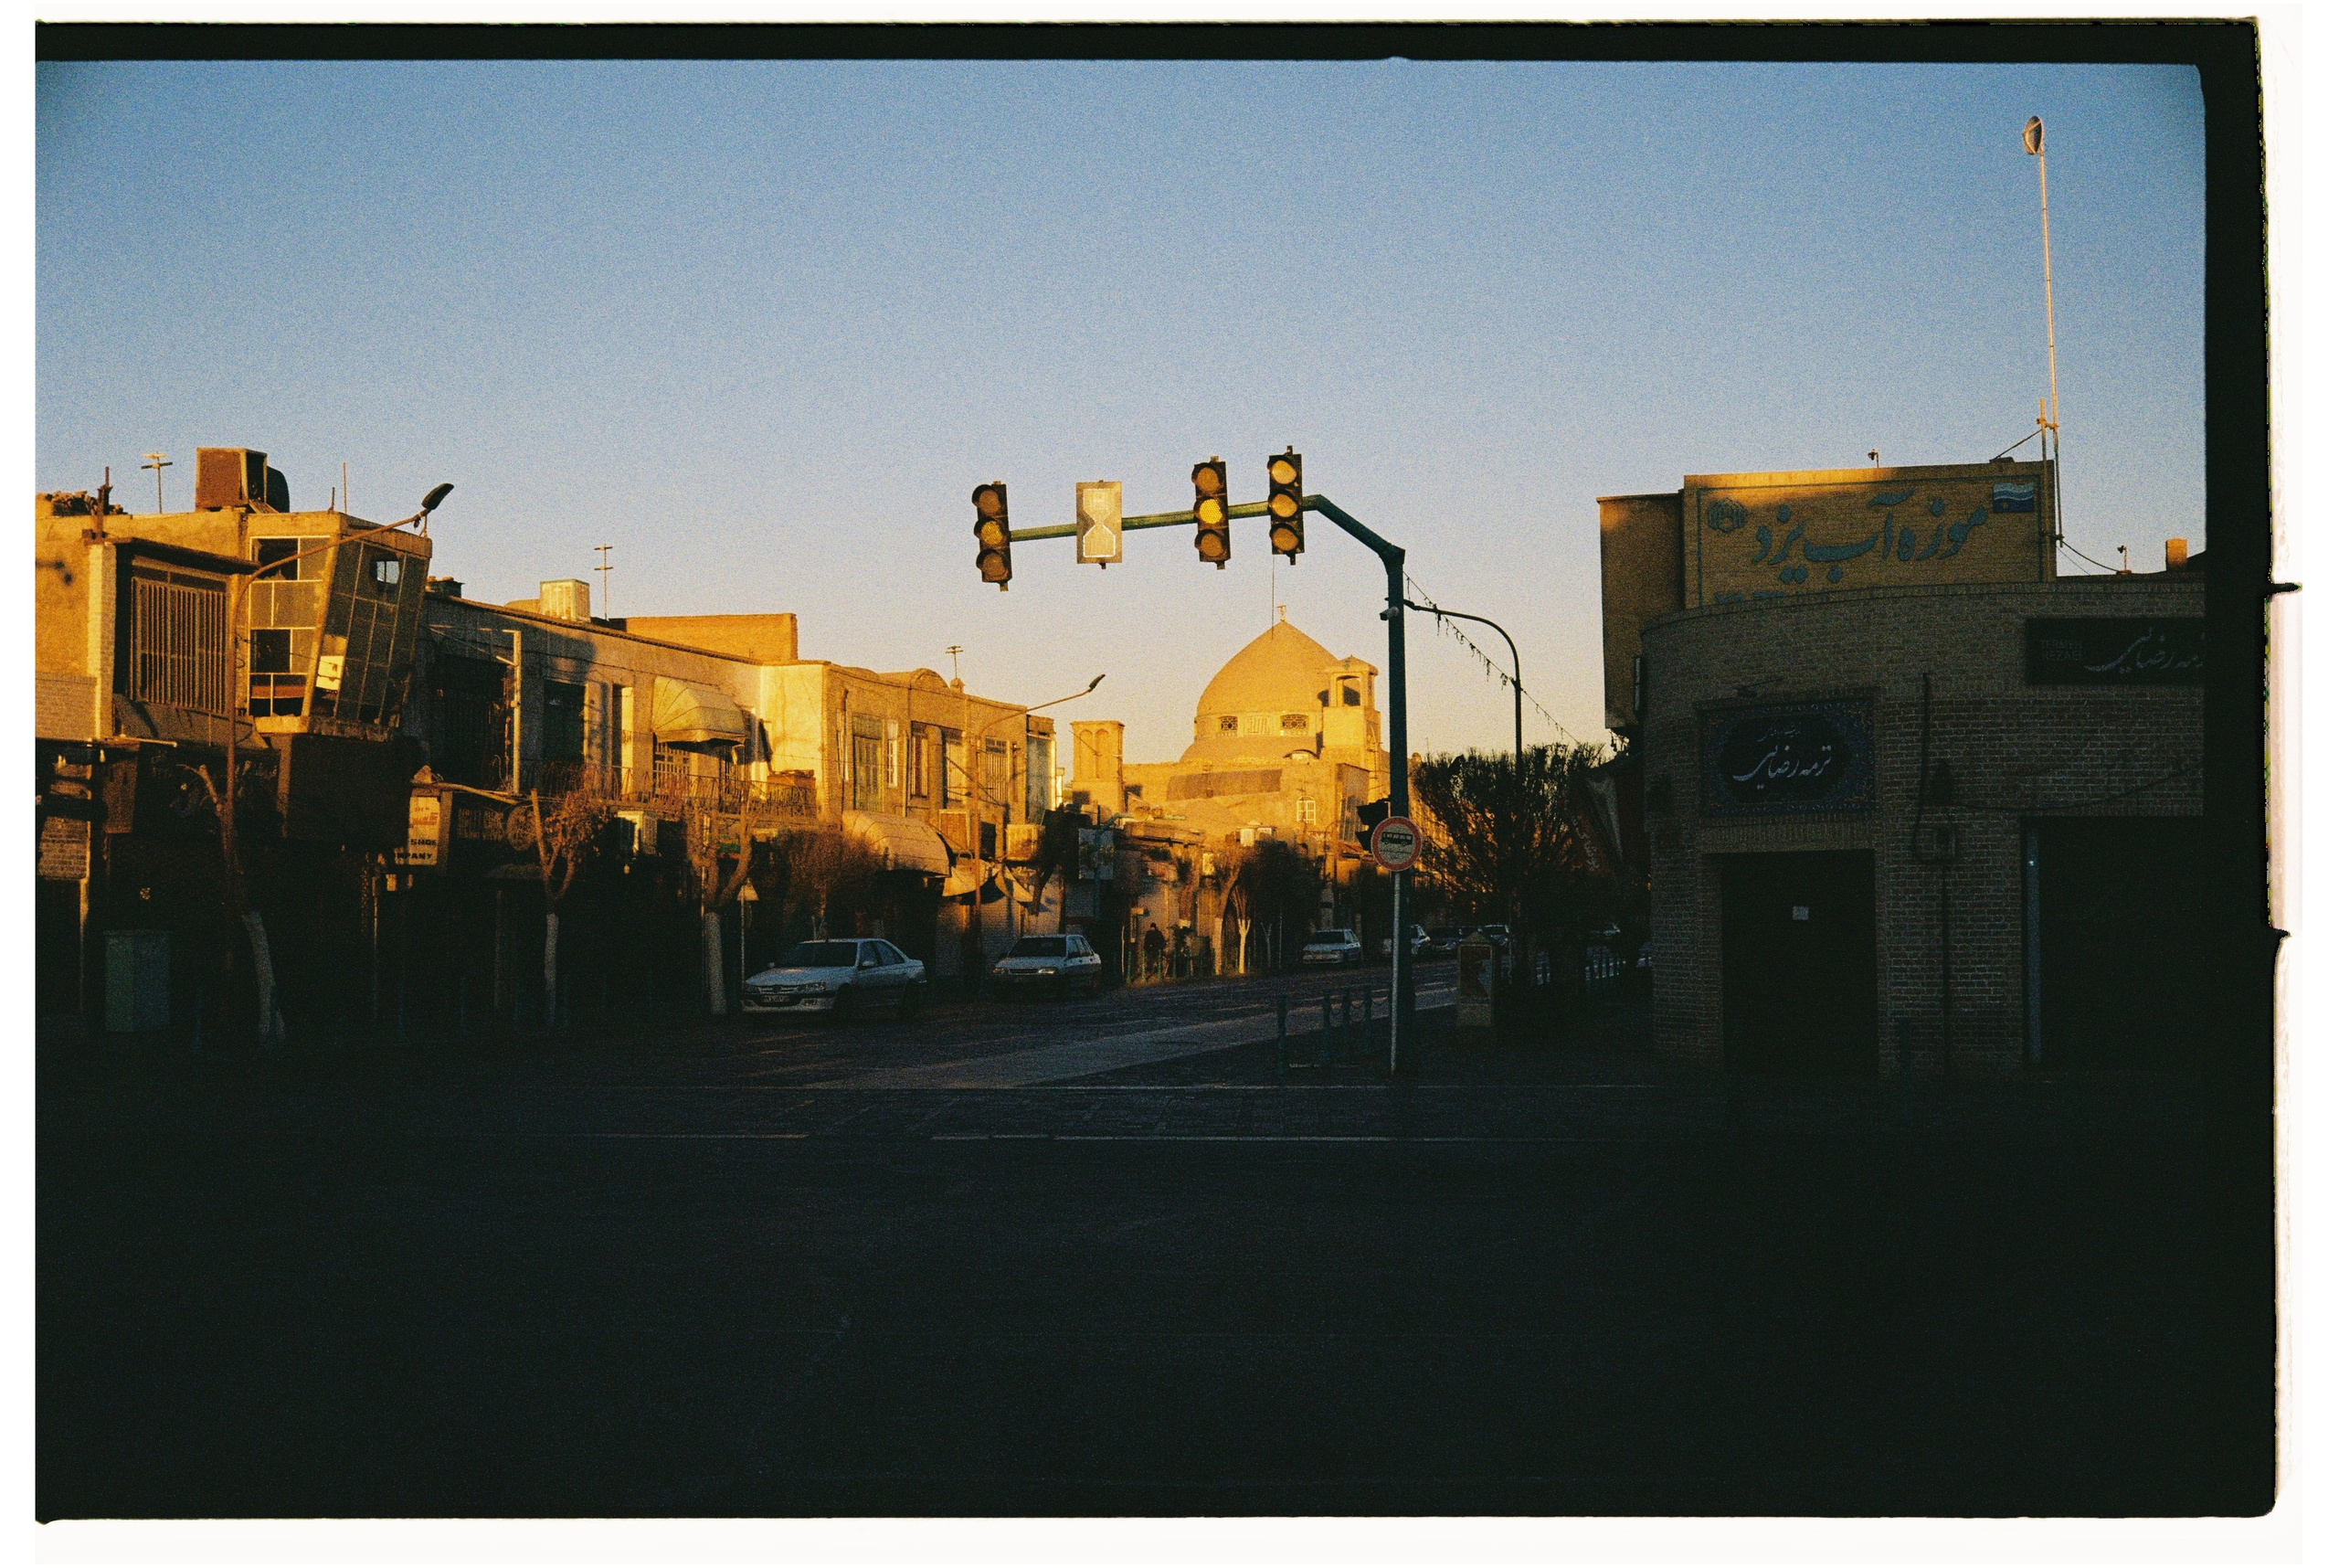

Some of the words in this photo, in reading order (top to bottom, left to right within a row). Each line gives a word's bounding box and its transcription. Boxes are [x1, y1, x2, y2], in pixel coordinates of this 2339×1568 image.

[1752, 504, 1808, 583] یزد
[1804, 487, 1914, 583] آب
[1899, 497, 1987, 561] موزه
[1799, 744, 1832, 777] ترمه
